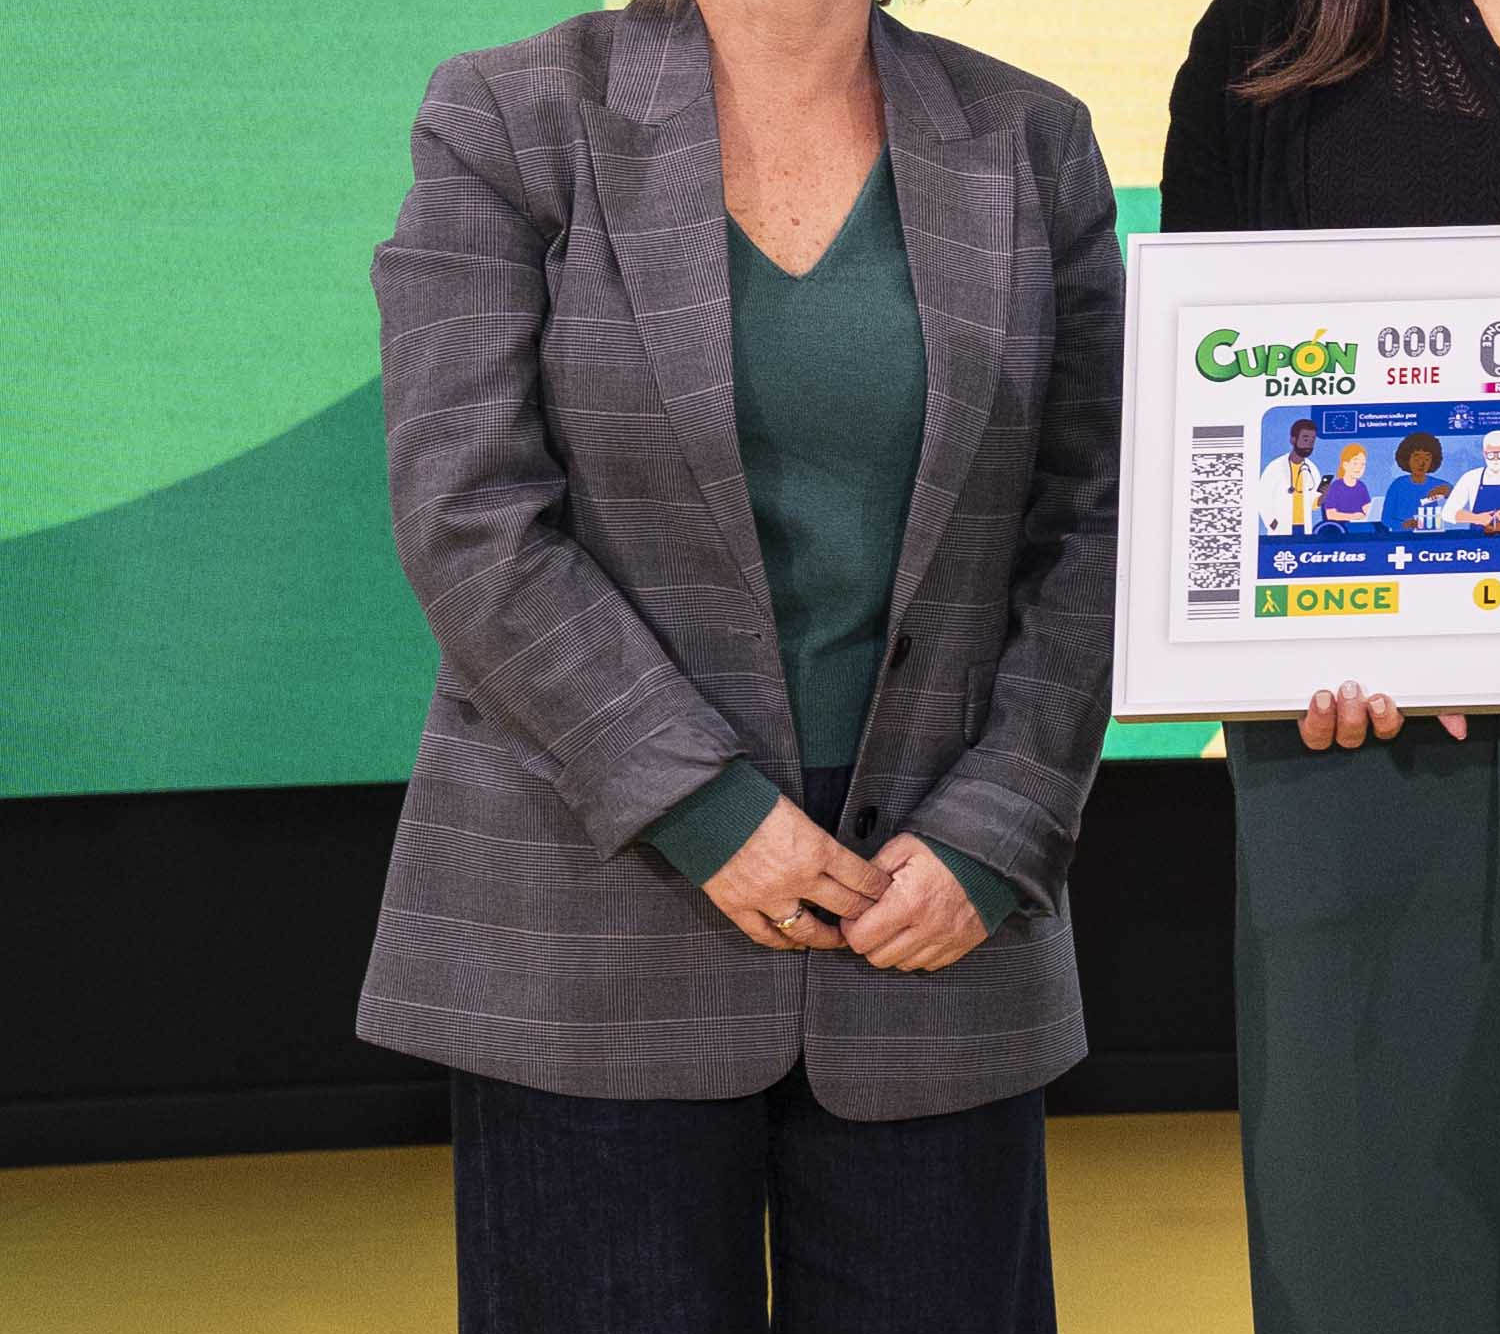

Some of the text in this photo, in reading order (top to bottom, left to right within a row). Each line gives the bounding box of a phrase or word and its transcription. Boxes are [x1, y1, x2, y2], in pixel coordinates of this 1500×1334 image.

[1387, 366, 1440, 384] SERIE
[1299, 550, 1365, 563] Cáritas
[1418, 549, 1489, 563] Cruz Roja
[1296, 586, 1391, 611] ONCE
